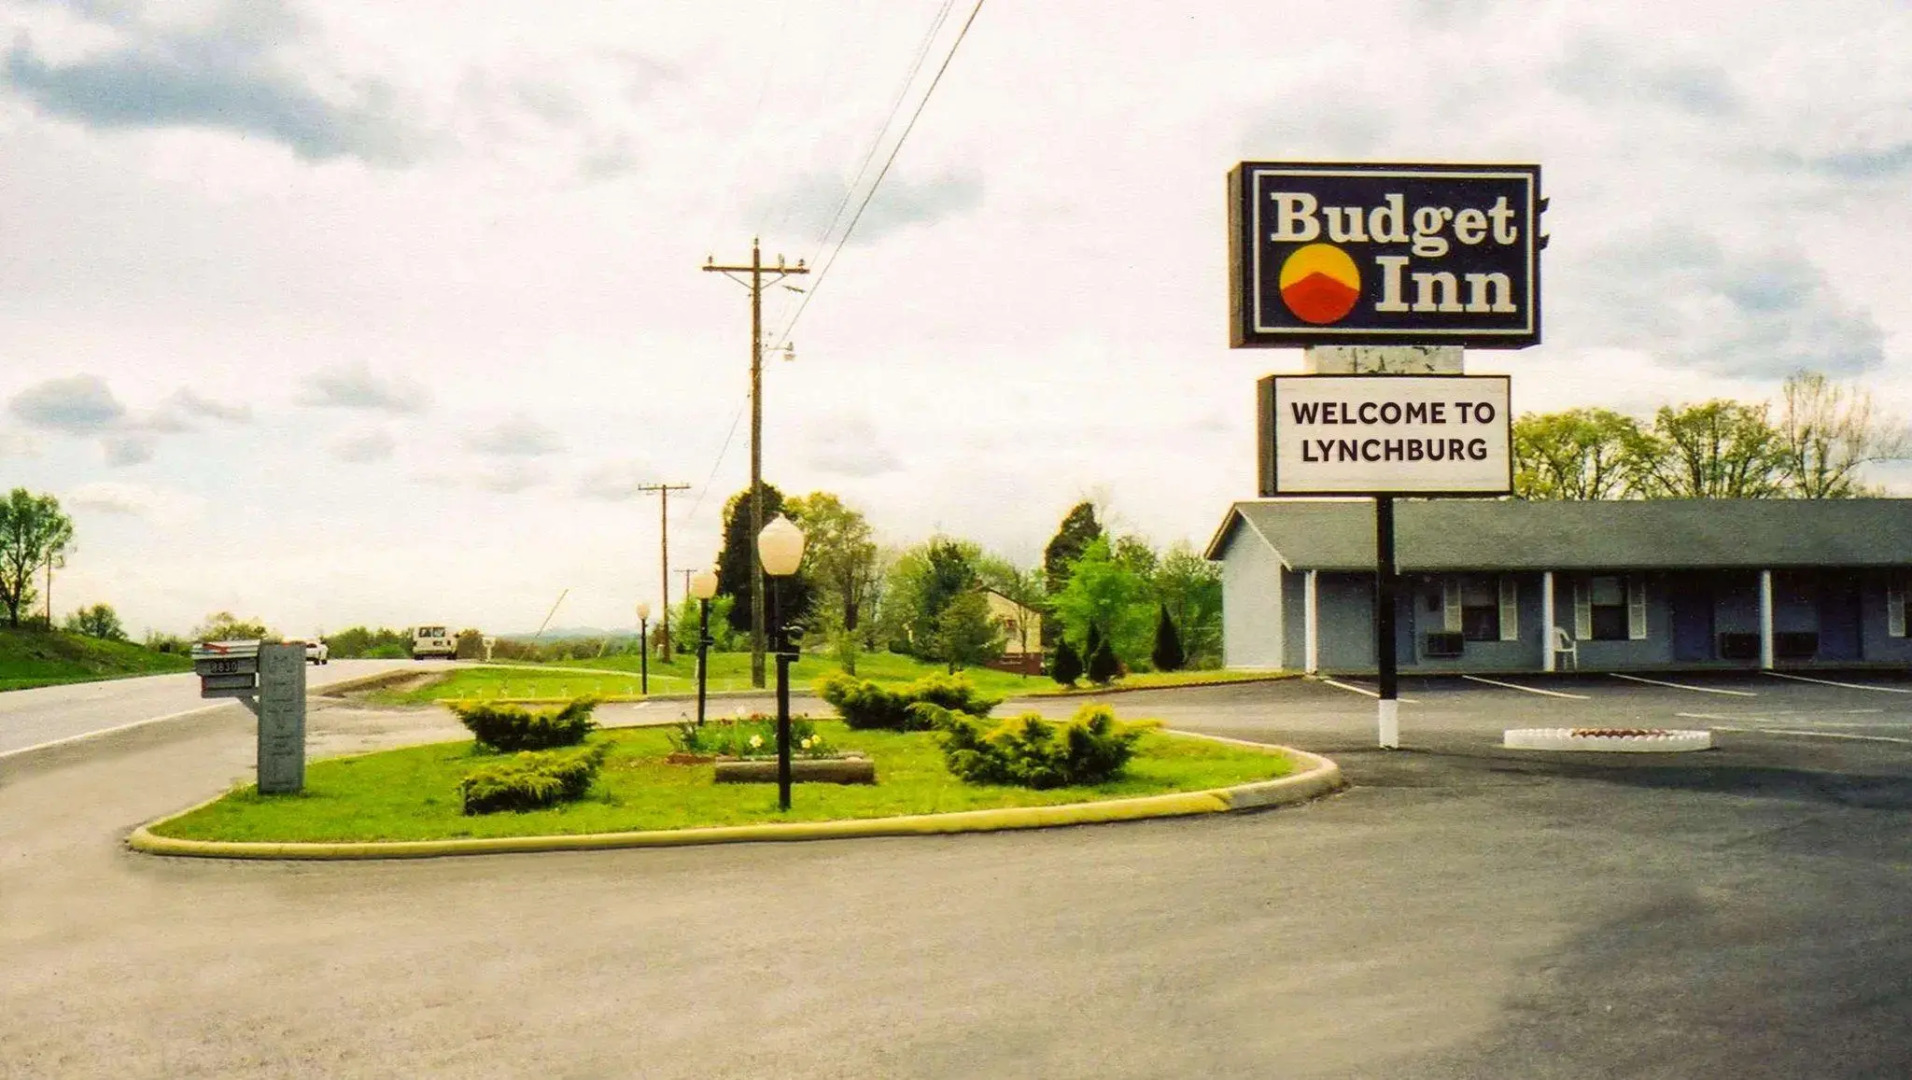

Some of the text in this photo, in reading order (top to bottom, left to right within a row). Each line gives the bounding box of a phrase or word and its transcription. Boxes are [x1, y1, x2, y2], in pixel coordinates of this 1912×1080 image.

[1270, 192, 1518, 257] Budget
[1375, 256, 1517, 313] Inn
[1291, 402, 1496, 424] WELCOME TO
[1303, 438, 1488, 462] LYNCHBURG
